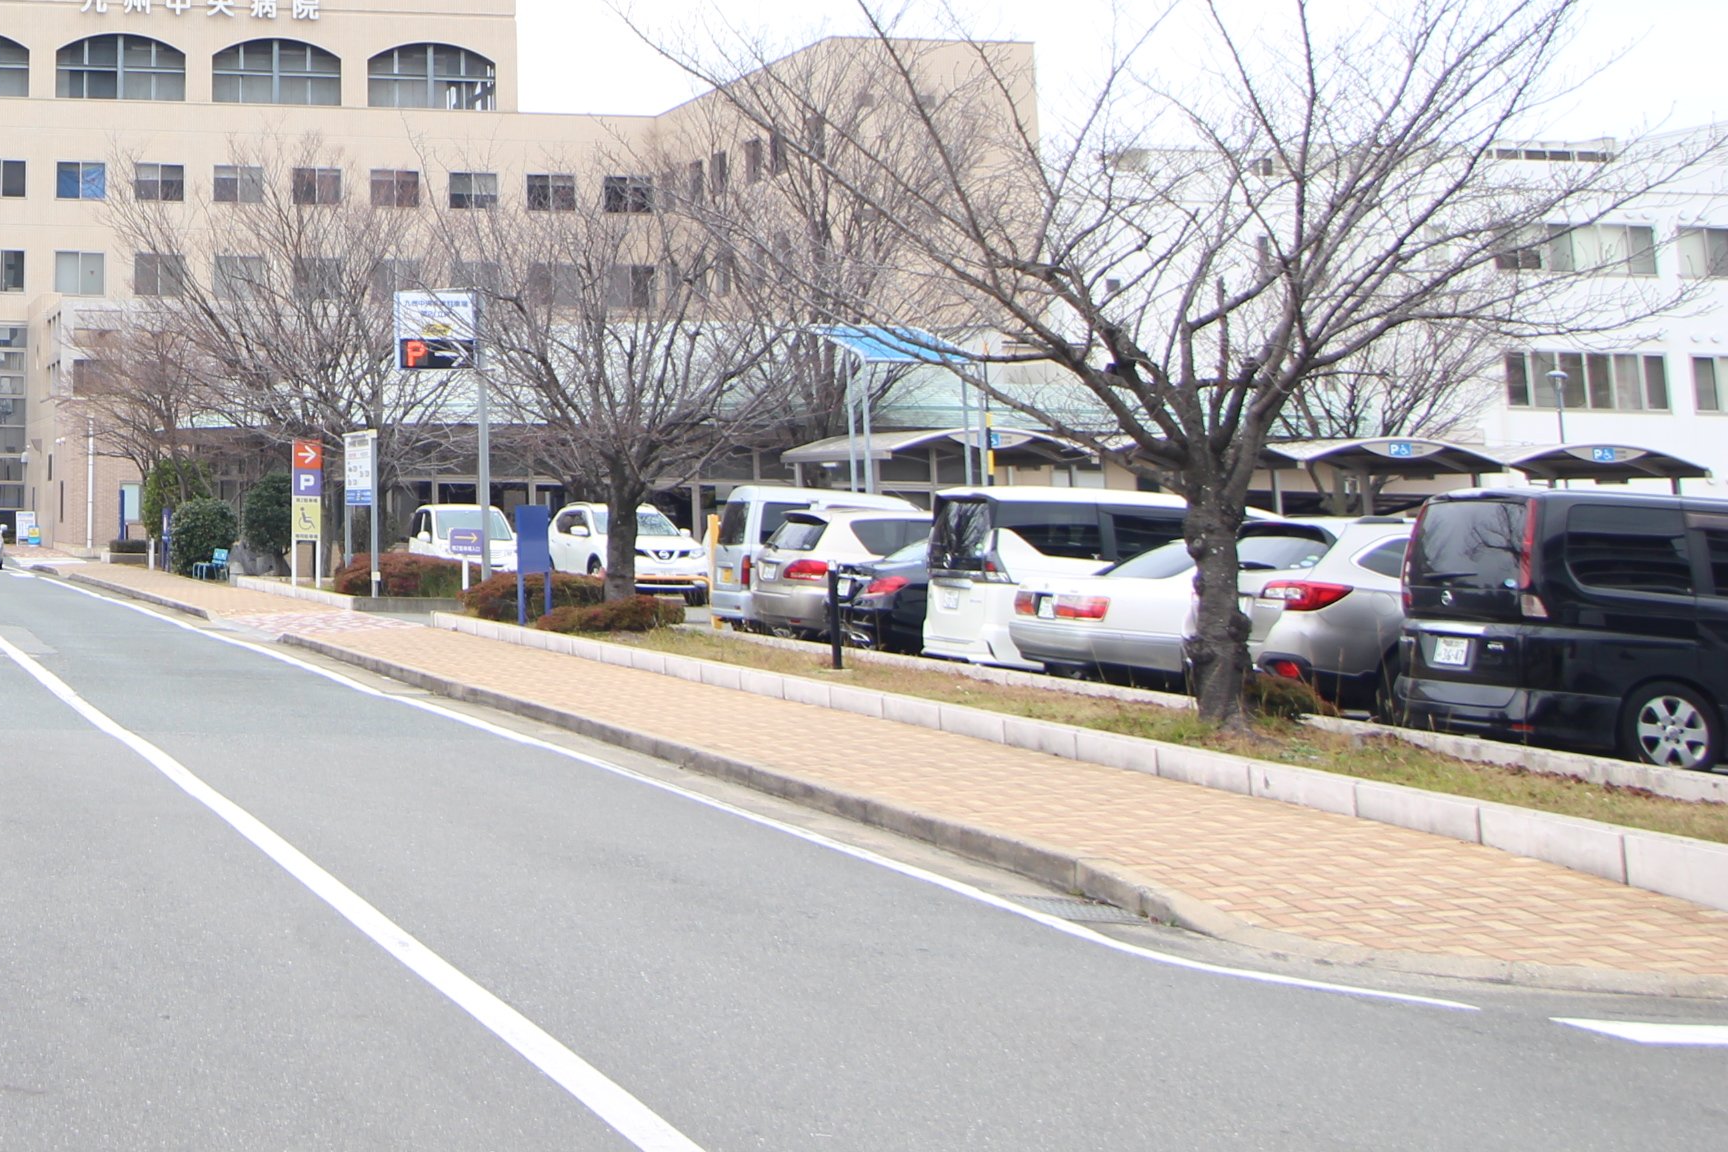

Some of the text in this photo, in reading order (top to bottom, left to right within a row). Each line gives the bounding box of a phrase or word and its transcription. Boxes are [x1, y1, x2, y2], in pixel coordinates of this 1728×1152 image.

[407, 340, 428, 367] P
[1390, 444, 1399, 455] P
[1593, 448, 1602, 459] P
[300, 474, 315, 491] P
